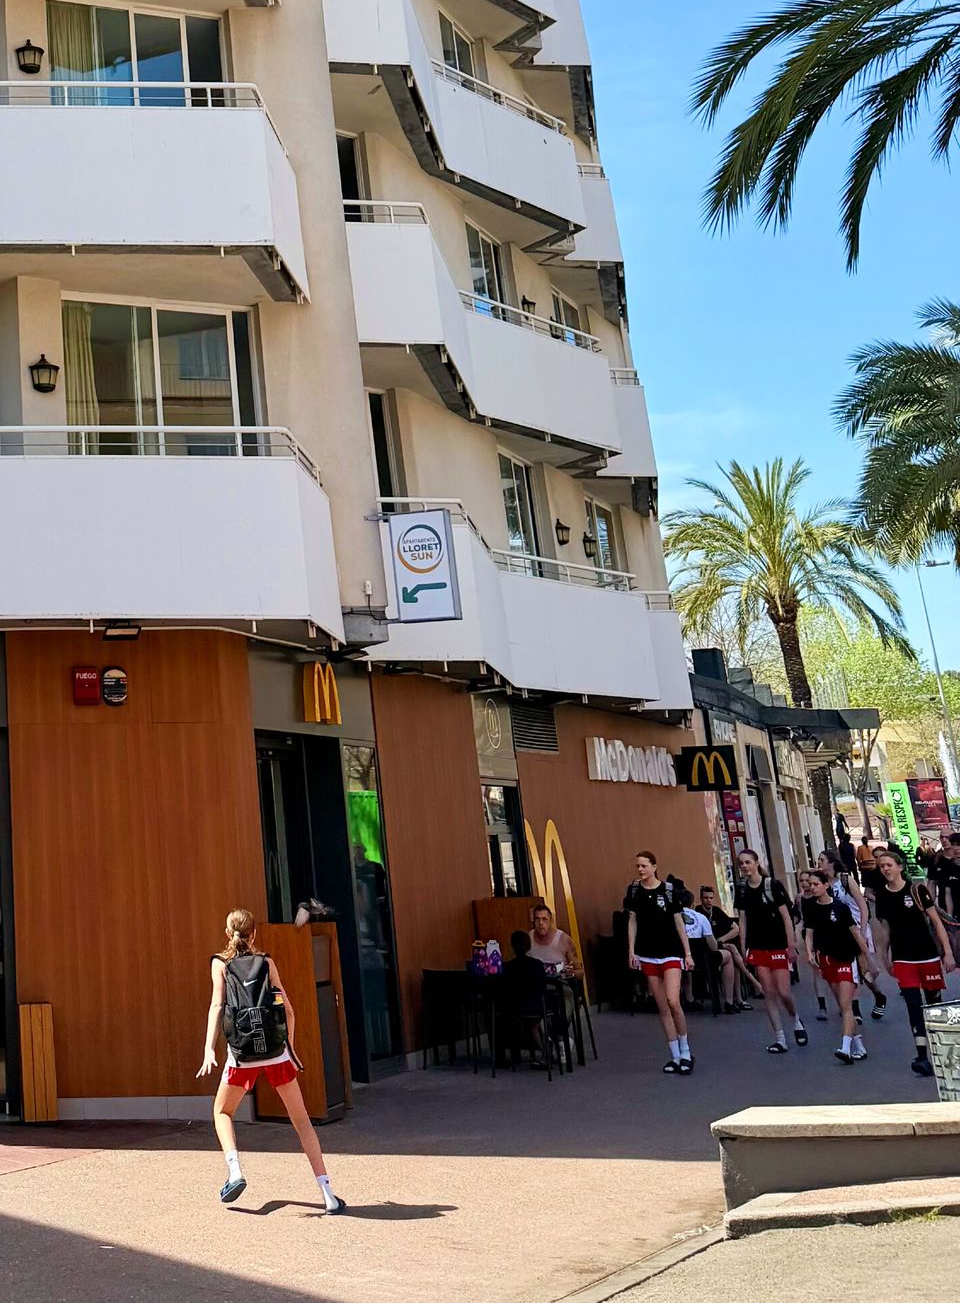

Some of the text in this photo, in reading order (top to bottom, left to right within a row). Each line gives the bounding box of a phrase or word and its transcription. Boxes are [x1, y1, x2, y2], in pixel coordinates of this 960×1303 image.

[403, 543, 439, 553] LLORET
[411, 551, 433, 561] SUN
[76, 672, 97, 680] FUEGO
